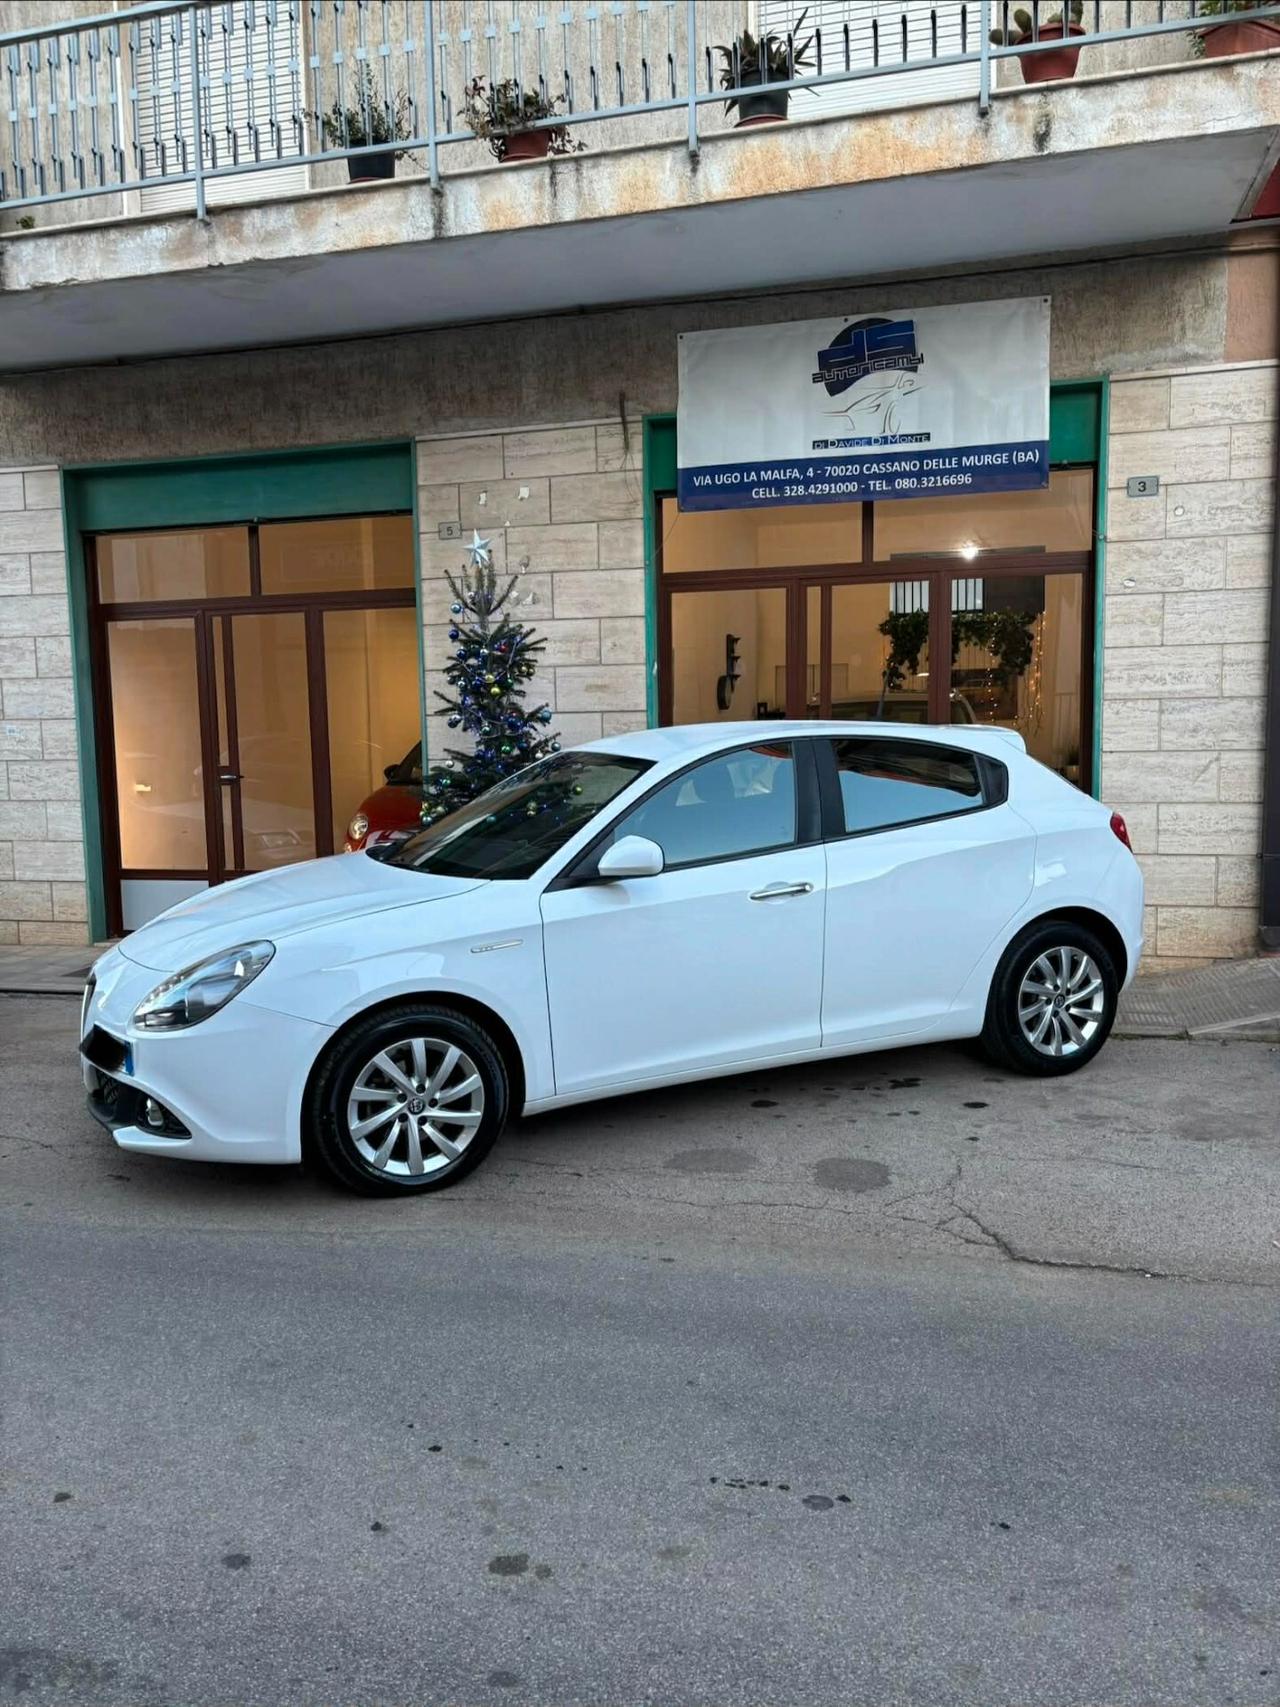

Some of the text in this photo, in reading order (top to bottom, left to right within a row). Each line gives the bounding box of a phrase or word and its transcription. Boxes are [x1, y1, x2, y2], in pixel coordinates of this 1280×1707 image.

[693, 475, 712, 487] VIA
[715, 472, 741, 484] UGO
[743, 471, 758, 482] LA
[760, 468, 803, 482] MALFA,
[806, 467, 814, 478] 4
[824, 464, 860, 477] 70020
[862, 460, 920, 475] CASSANO
[923, 457, 959, 470] DELLE
[961, 453, 1009, 468] MURGE
[1012, 449, 1040, 465] (BA)
[752, 487, 781, 499] CELL.
[783, 481, 858, 497] 328.4291000
[868, 480, 892, 491] TEL.
[894, 473, 973, 489] 080.3216696
[1138, 481, 1146, 492] 3
[446, 526, 453, 536] 5
